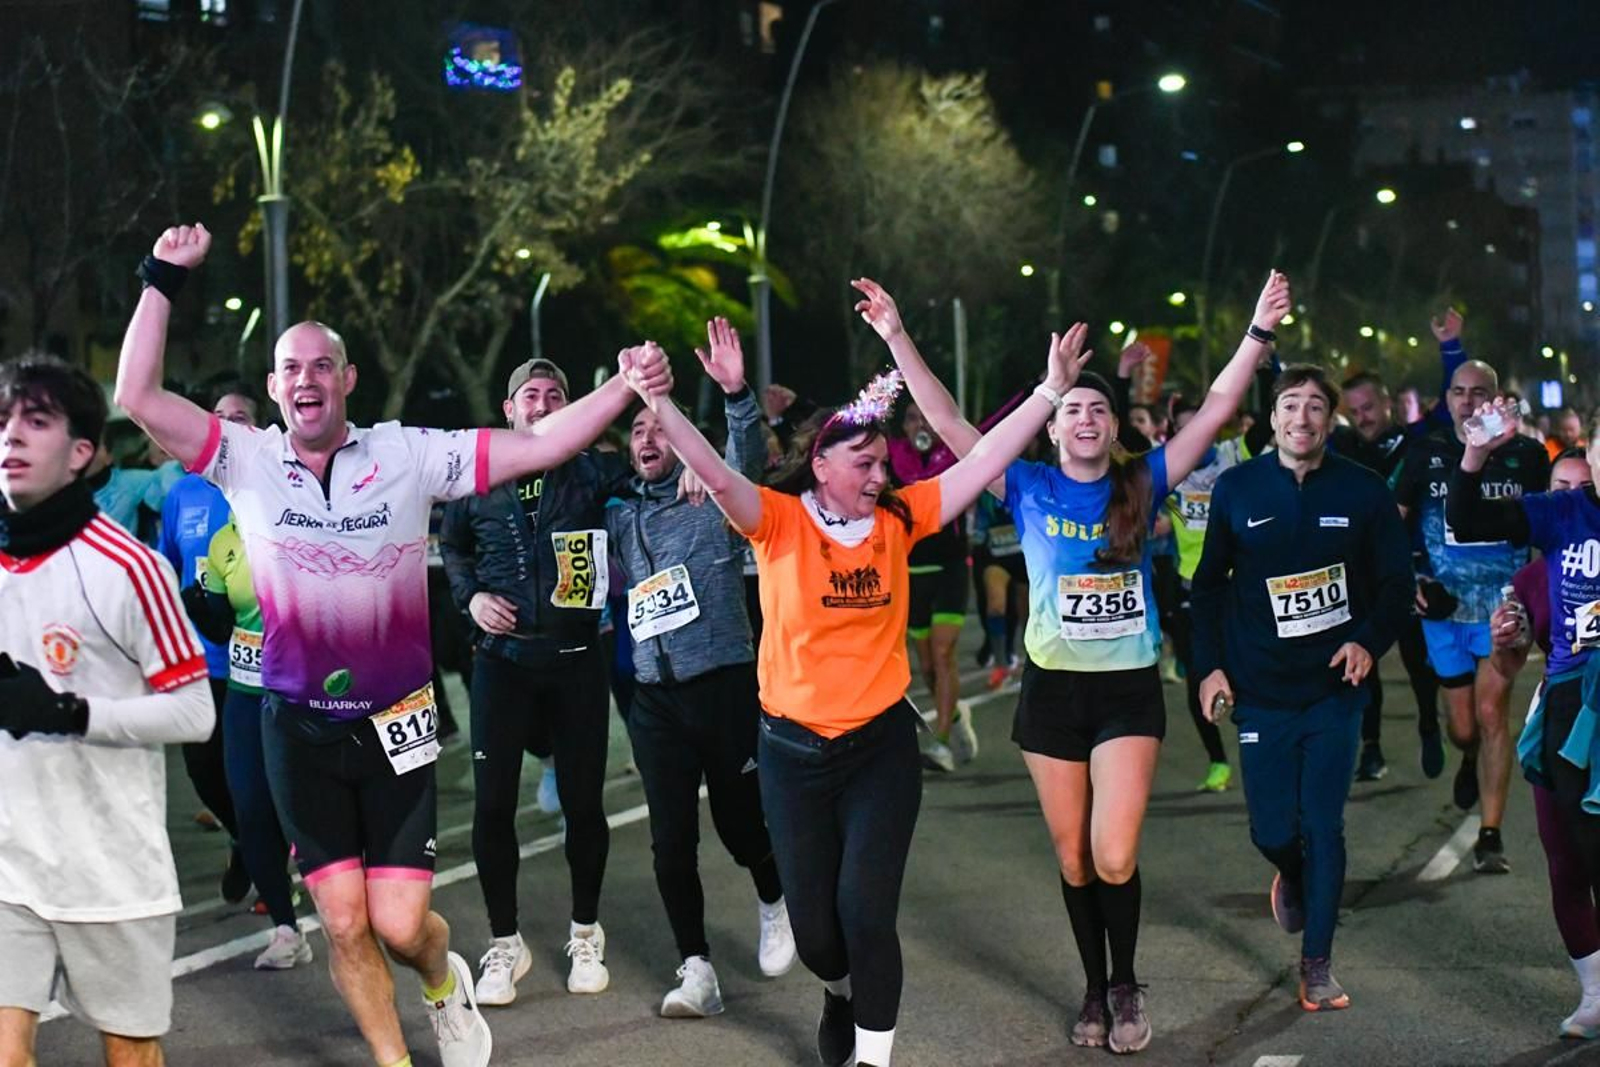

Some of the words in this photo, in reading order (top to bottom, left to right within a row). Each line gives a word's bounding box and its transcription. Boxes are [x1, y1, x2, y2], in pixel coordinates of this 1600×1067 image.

[1429, 482, 1449, 498] SA
[1480, 479, 1523, 499] NTÓN
[275, 508, 323, 529] SIERRA
[337, 514, 389, 532] SEGURA
[1187, 502, 1209, 517] 53
[568, 538, 590, 601] 3206
[1066, 590, 1137, 616] 7356
[1277, 582, 1341, 615] 7510
